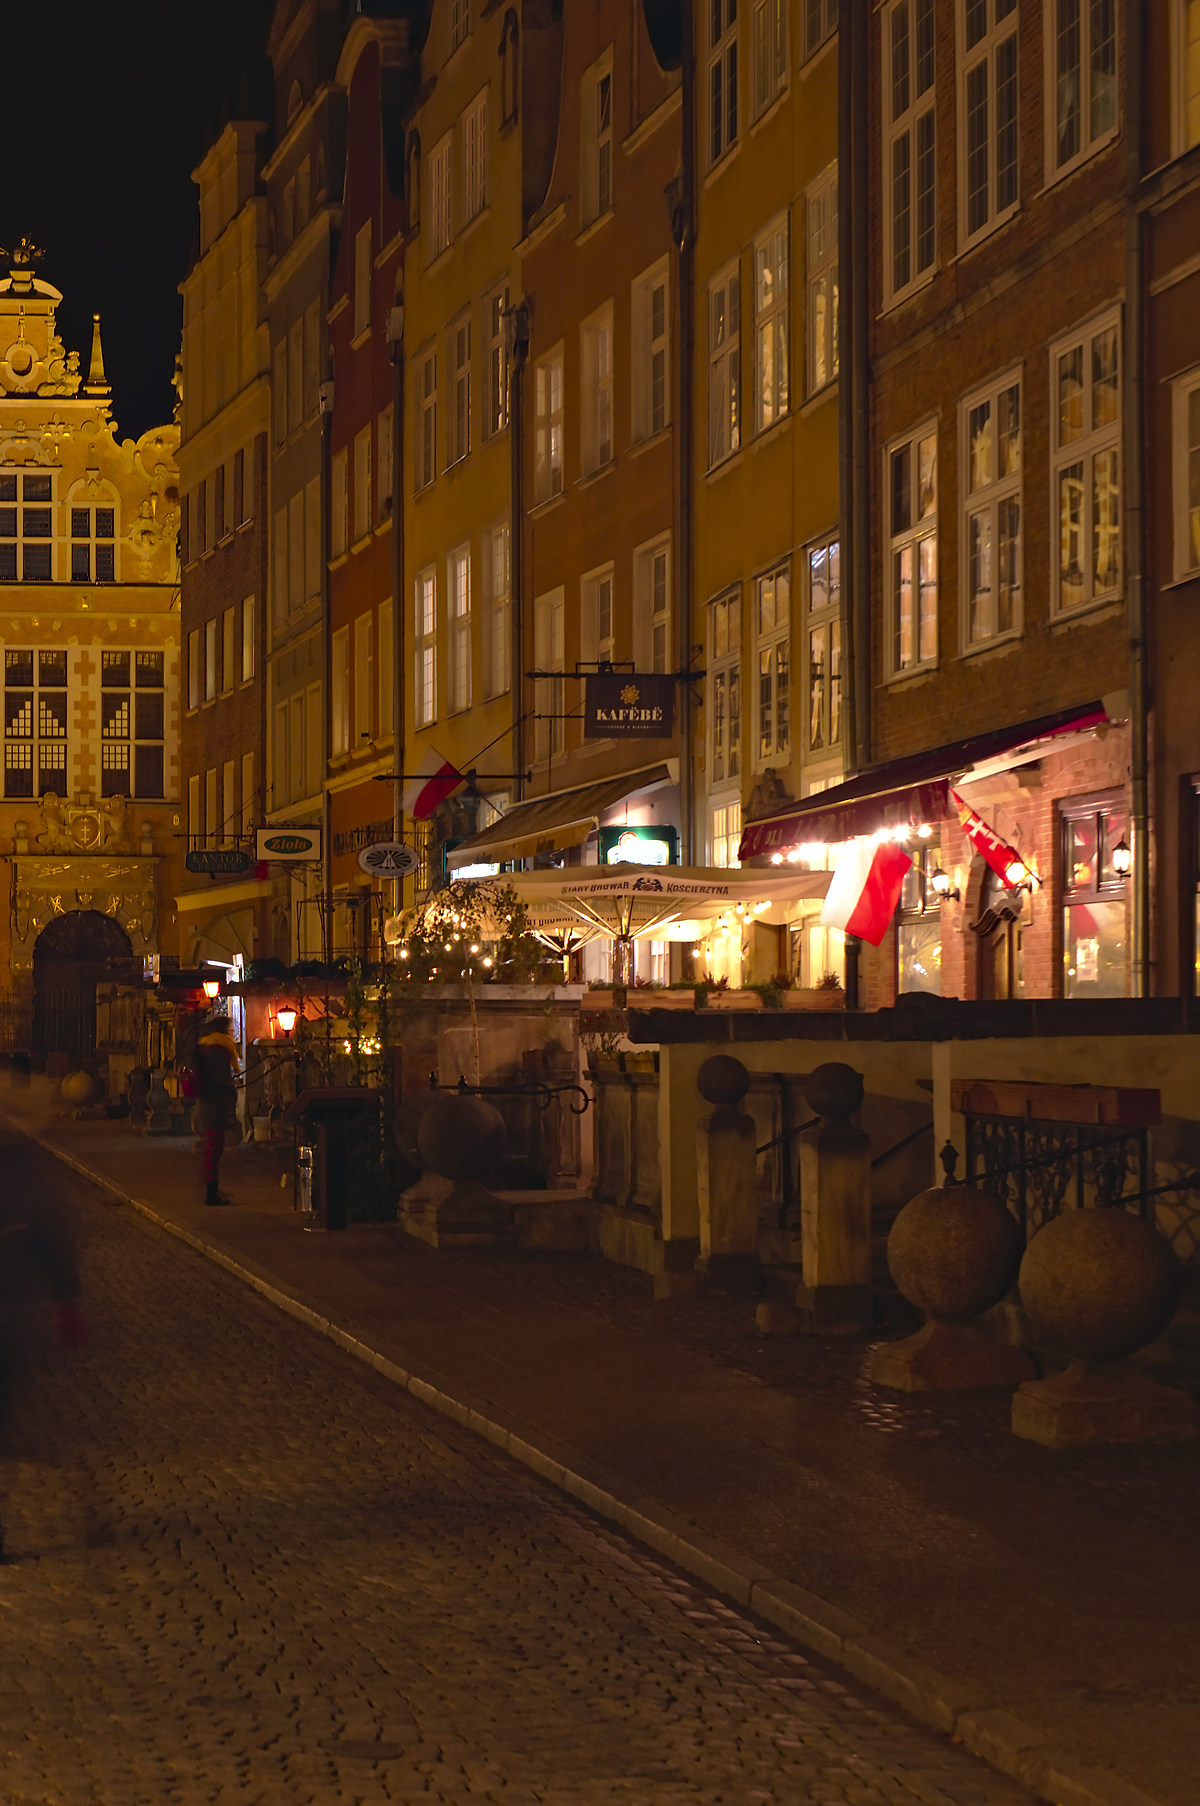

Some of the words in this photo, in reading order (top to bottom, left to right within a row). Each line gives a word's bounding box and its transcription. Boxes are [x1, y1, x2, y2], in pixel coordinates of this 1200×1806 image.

[596, 706, 663, 721] KAFËBË
[192, 854, 243, 864] KANTOR
[590, 881, 629, 892] BROWAR
[666, 883, 729, 895] KOŚCIERZYNA
